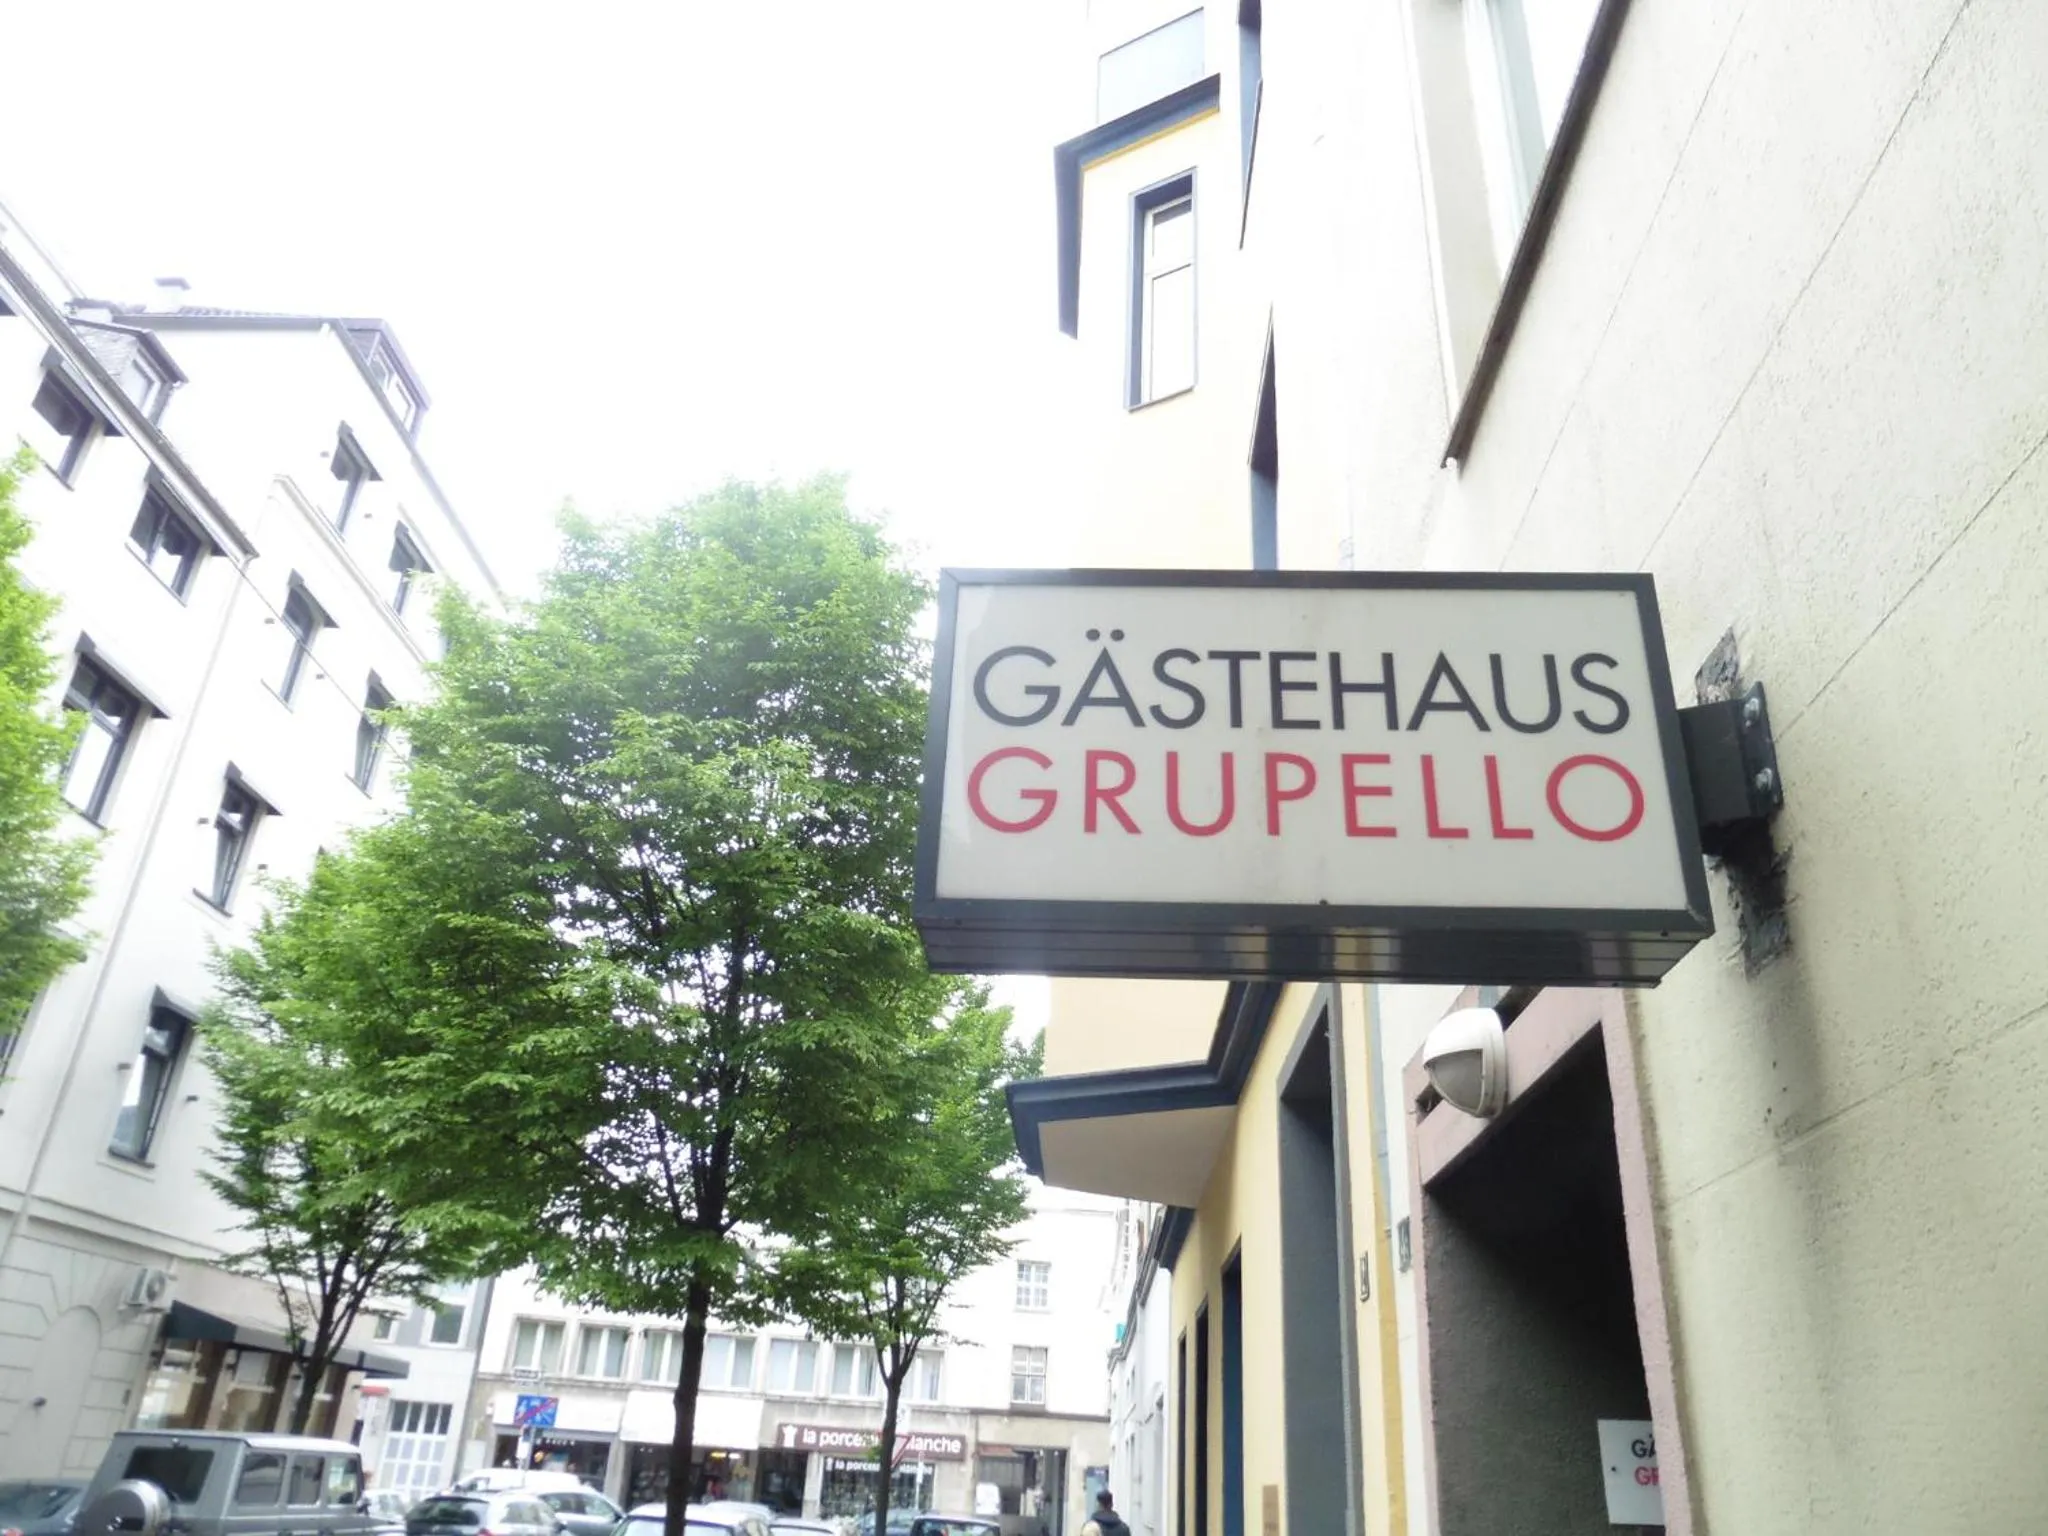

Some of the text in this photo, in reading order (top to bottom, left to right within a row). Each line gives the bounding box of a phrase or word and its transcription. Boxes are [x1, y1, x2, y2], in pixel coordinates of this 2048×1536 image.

[972, 628, 1631, 736] GÄSTEHAUS
[967, 746, 1645, 843] GRUPELLO
[803, 1429, 817, 1444] la
